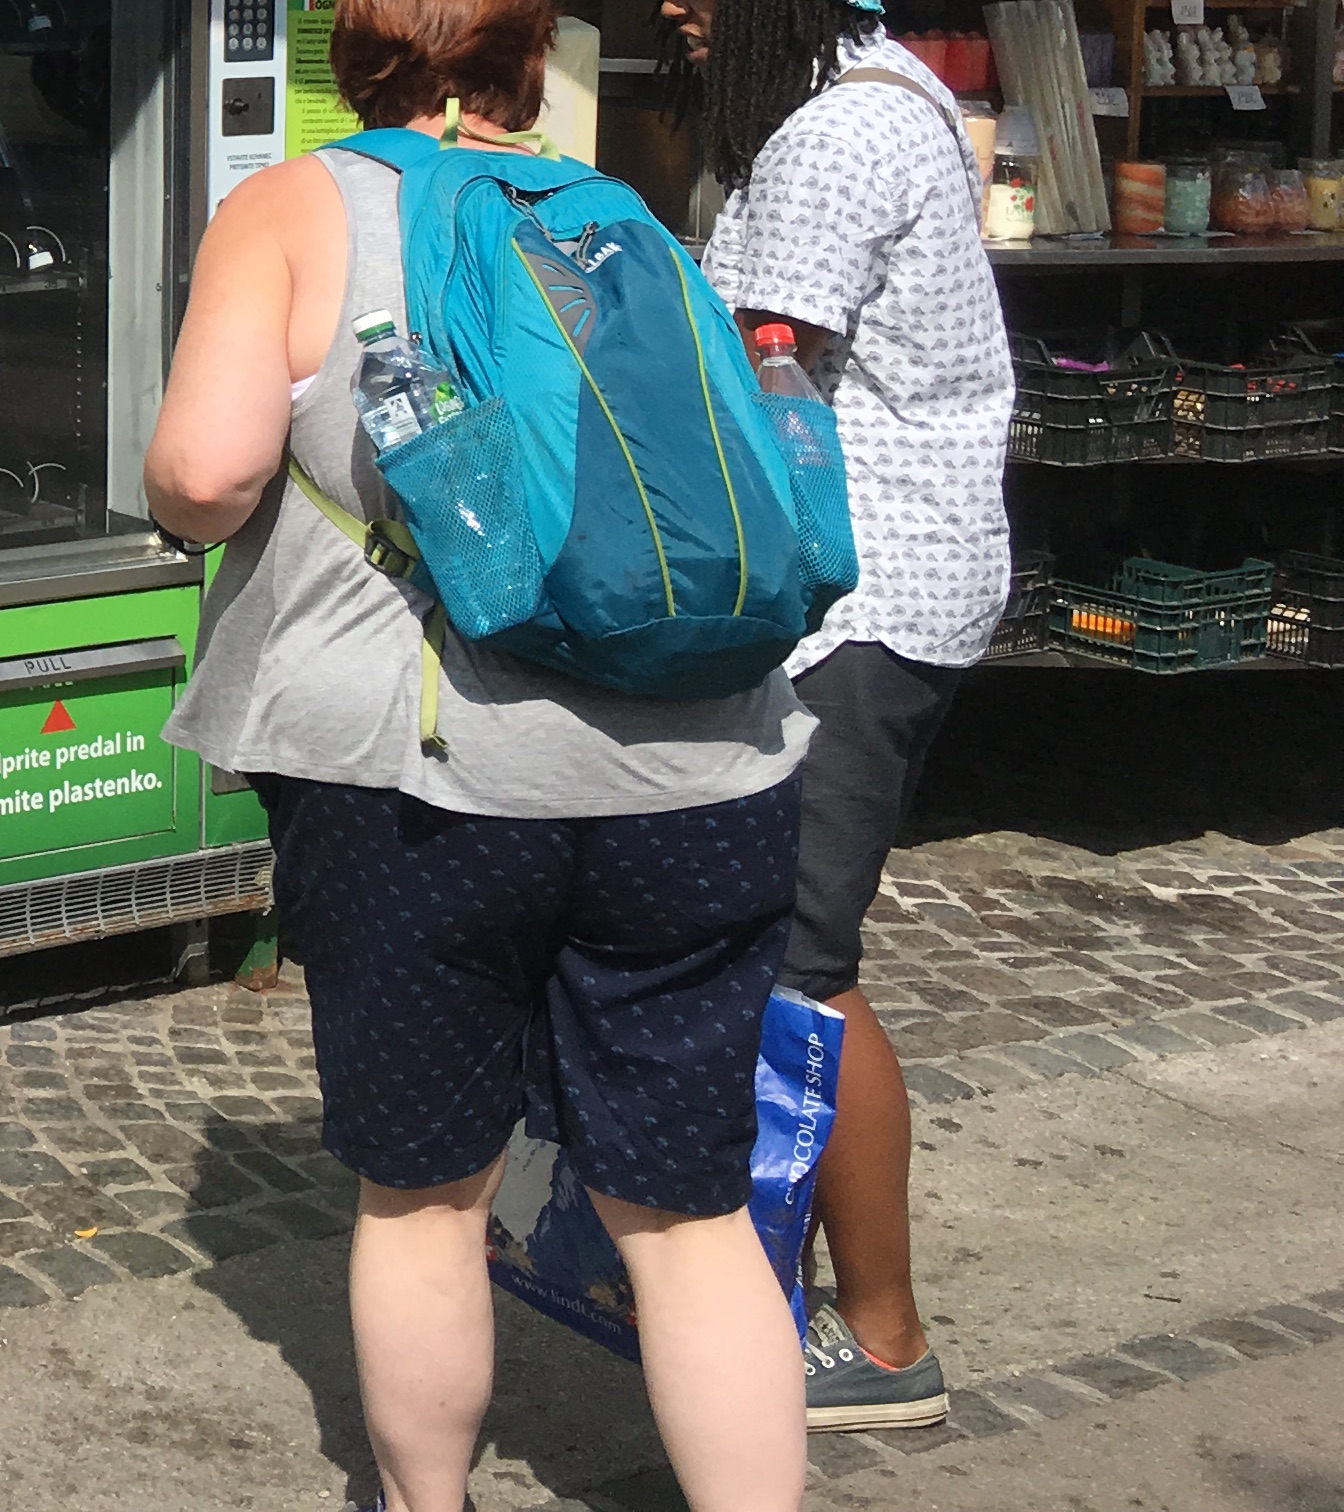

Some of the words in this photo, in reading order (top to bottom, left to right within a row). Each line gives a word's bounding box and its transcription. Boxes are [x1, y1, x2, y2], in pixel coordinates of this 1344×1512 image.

[315, 0, 336, 11] OGN
[23, 656, 72, 675] PULL
[55, 731, 121, 769] predal
[126, 731, 145, 752] in
[48, 767, 163, 813] plastenko.
[785, 1088, 823, 1206] COCOLATE
[804, 1032, 825, 1087] SHOP
